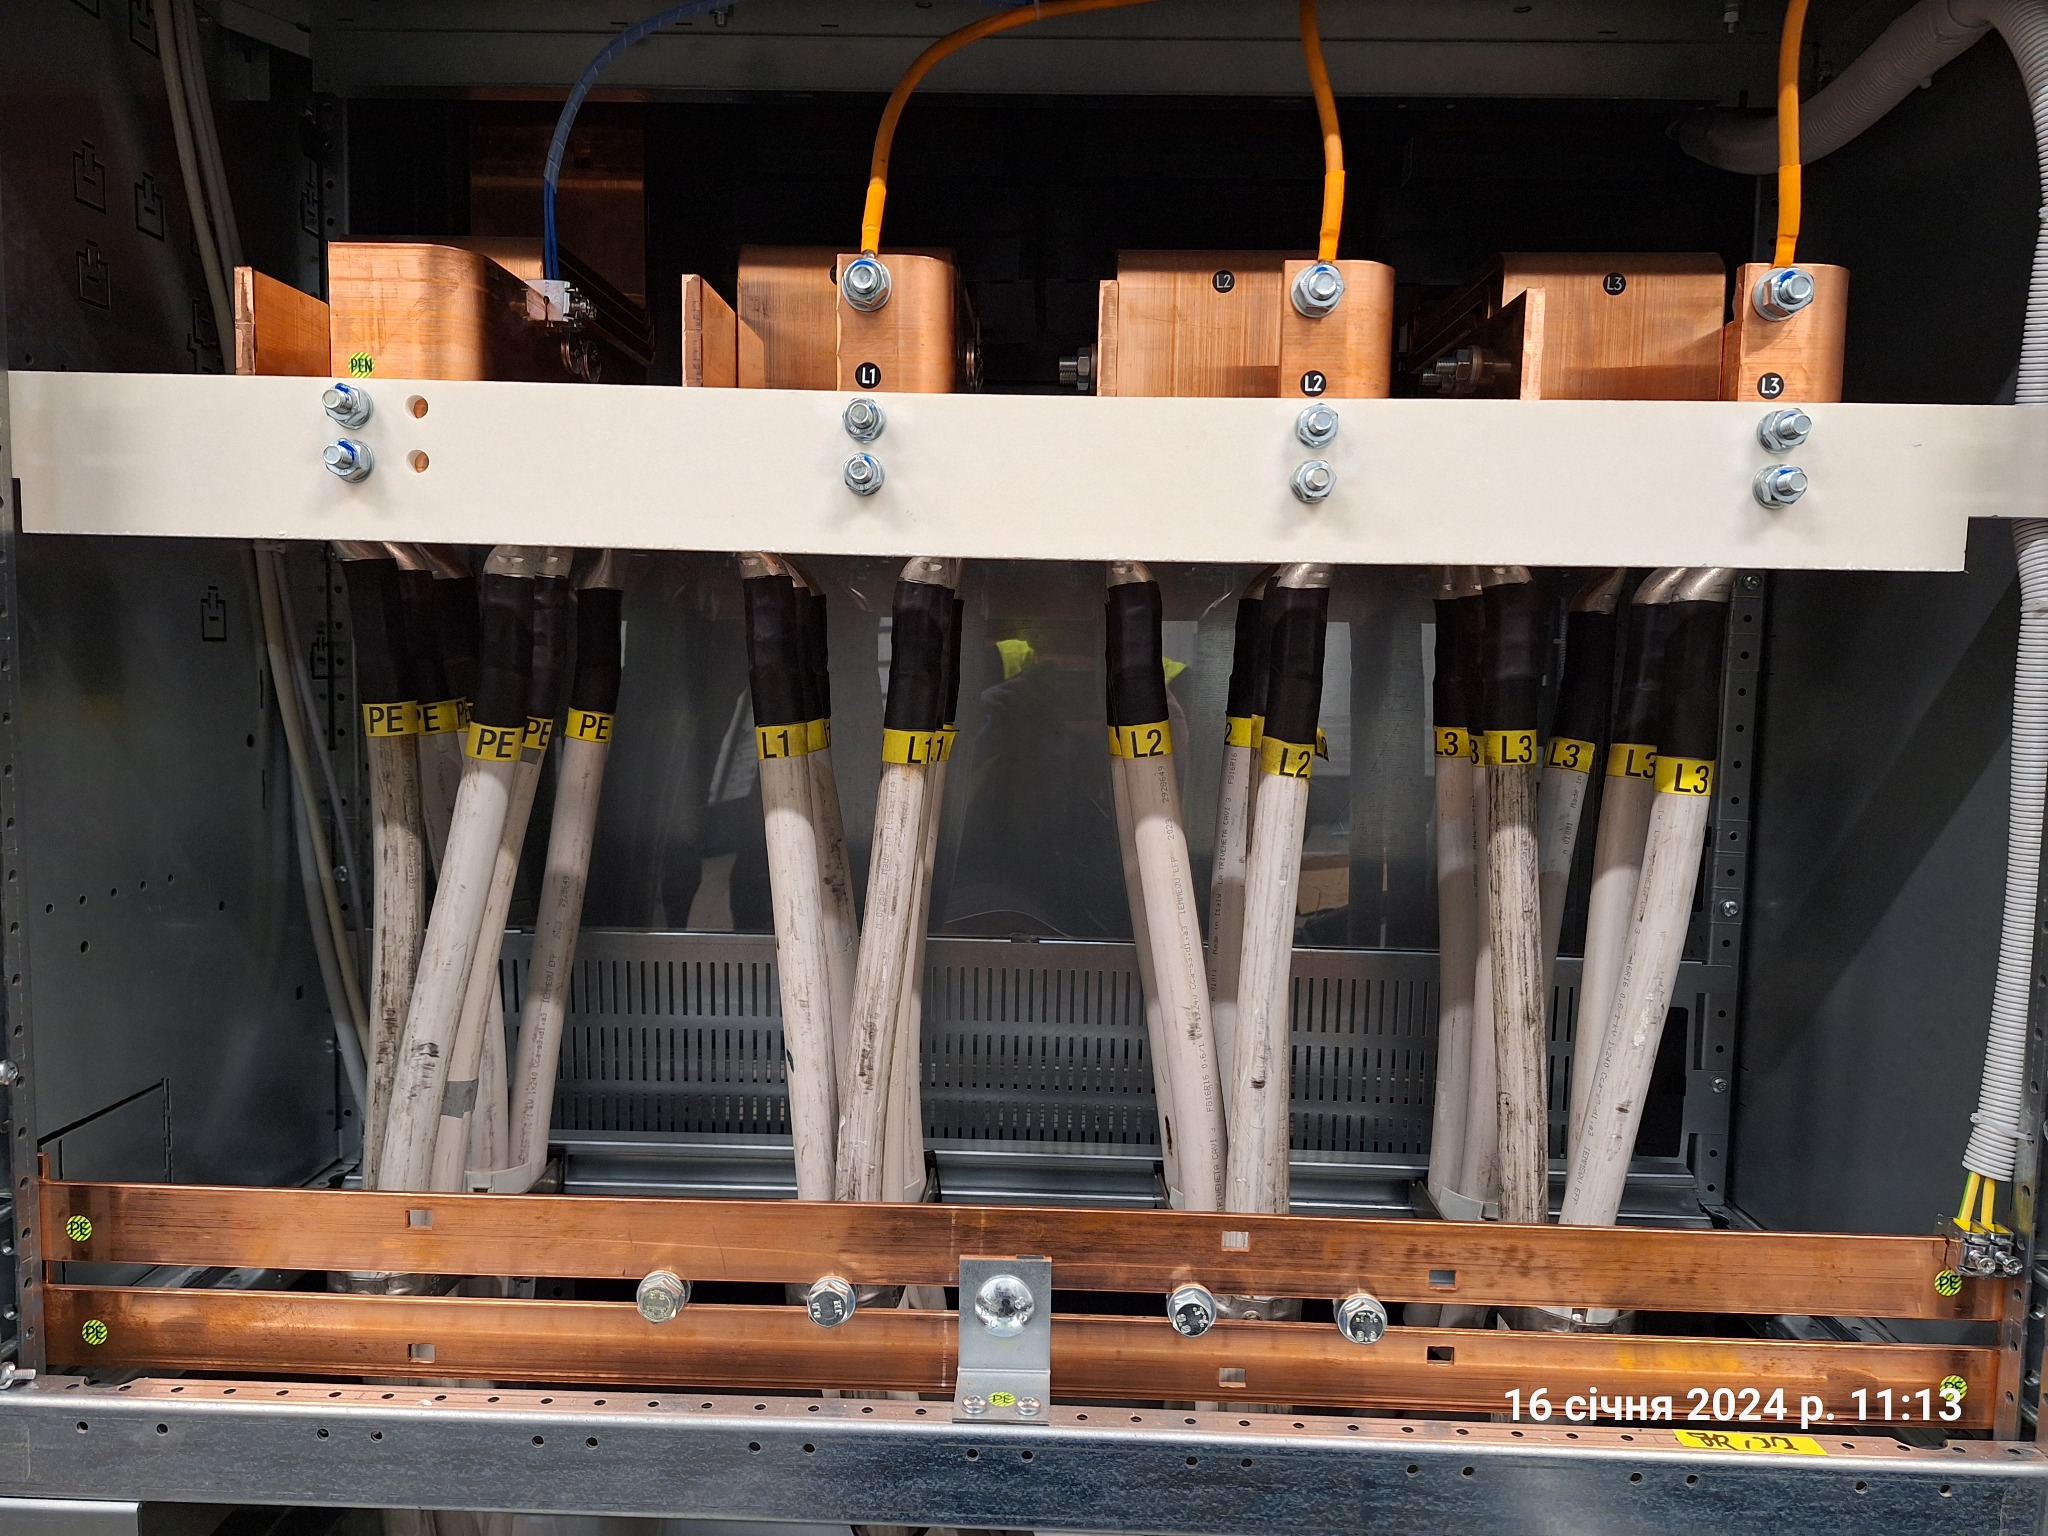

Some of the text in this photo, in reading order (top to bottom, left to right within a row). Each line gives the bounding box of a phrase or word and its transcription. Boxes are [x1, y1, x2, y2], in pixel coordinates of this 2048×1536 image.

[1216, 274, 1231, 289] L2
[1606, 276, 1623, 291] L3
[350, 357, 373, 373] PEN
[861, 366, 876, 384] L1
[1304, 374, 1323, 392] L2
[1760, 377, 1781, 394] L3
[369, 705, 404, 734] PE
[579, 713, 610, 740] PE
[475, 728, 516, 759] PE
[521, 718, 551, 747] PE
[761, 729, 790, 759] L1
[1130, 728, 1165, 759] L2
[1434, 730, 1459, 756] L3
[906, 735, 932, 764] L1
[1500, 735, 1533, 764] L3
[1548, 741, 1581, 769] L3
[1227, 751, 1238, 785] FG16R16
[1278, 747, 1311, 779] L2
[1624, 748, 1656, 779] L3
[1157, 765, 1170, 804] 2928649
[1673, 762, 1710, 794] L3
[1569, 788, 1580, 810] Made
[1222, 806, 1232, 826] CAVI
[1165, 818, 1175, 841] 2023
[1218, 829, 1229, 870] TRIVENETA
[1171, 856, 1180, 875] EFP
[1214, 892, 1223, 917] Italy
[1202, 1073, 1214, 1113] FG16R16
[1209, 1138, 1219, 1160] CAVI
[1572, 1186, 1581, 1205] EFP
[69, 1221, 89, 1237] PE
[1939, 1274, 1960, 1290] PE
[84, 1325, 105, 1340] PE
[992, 1394, 1011, 1405] PE
